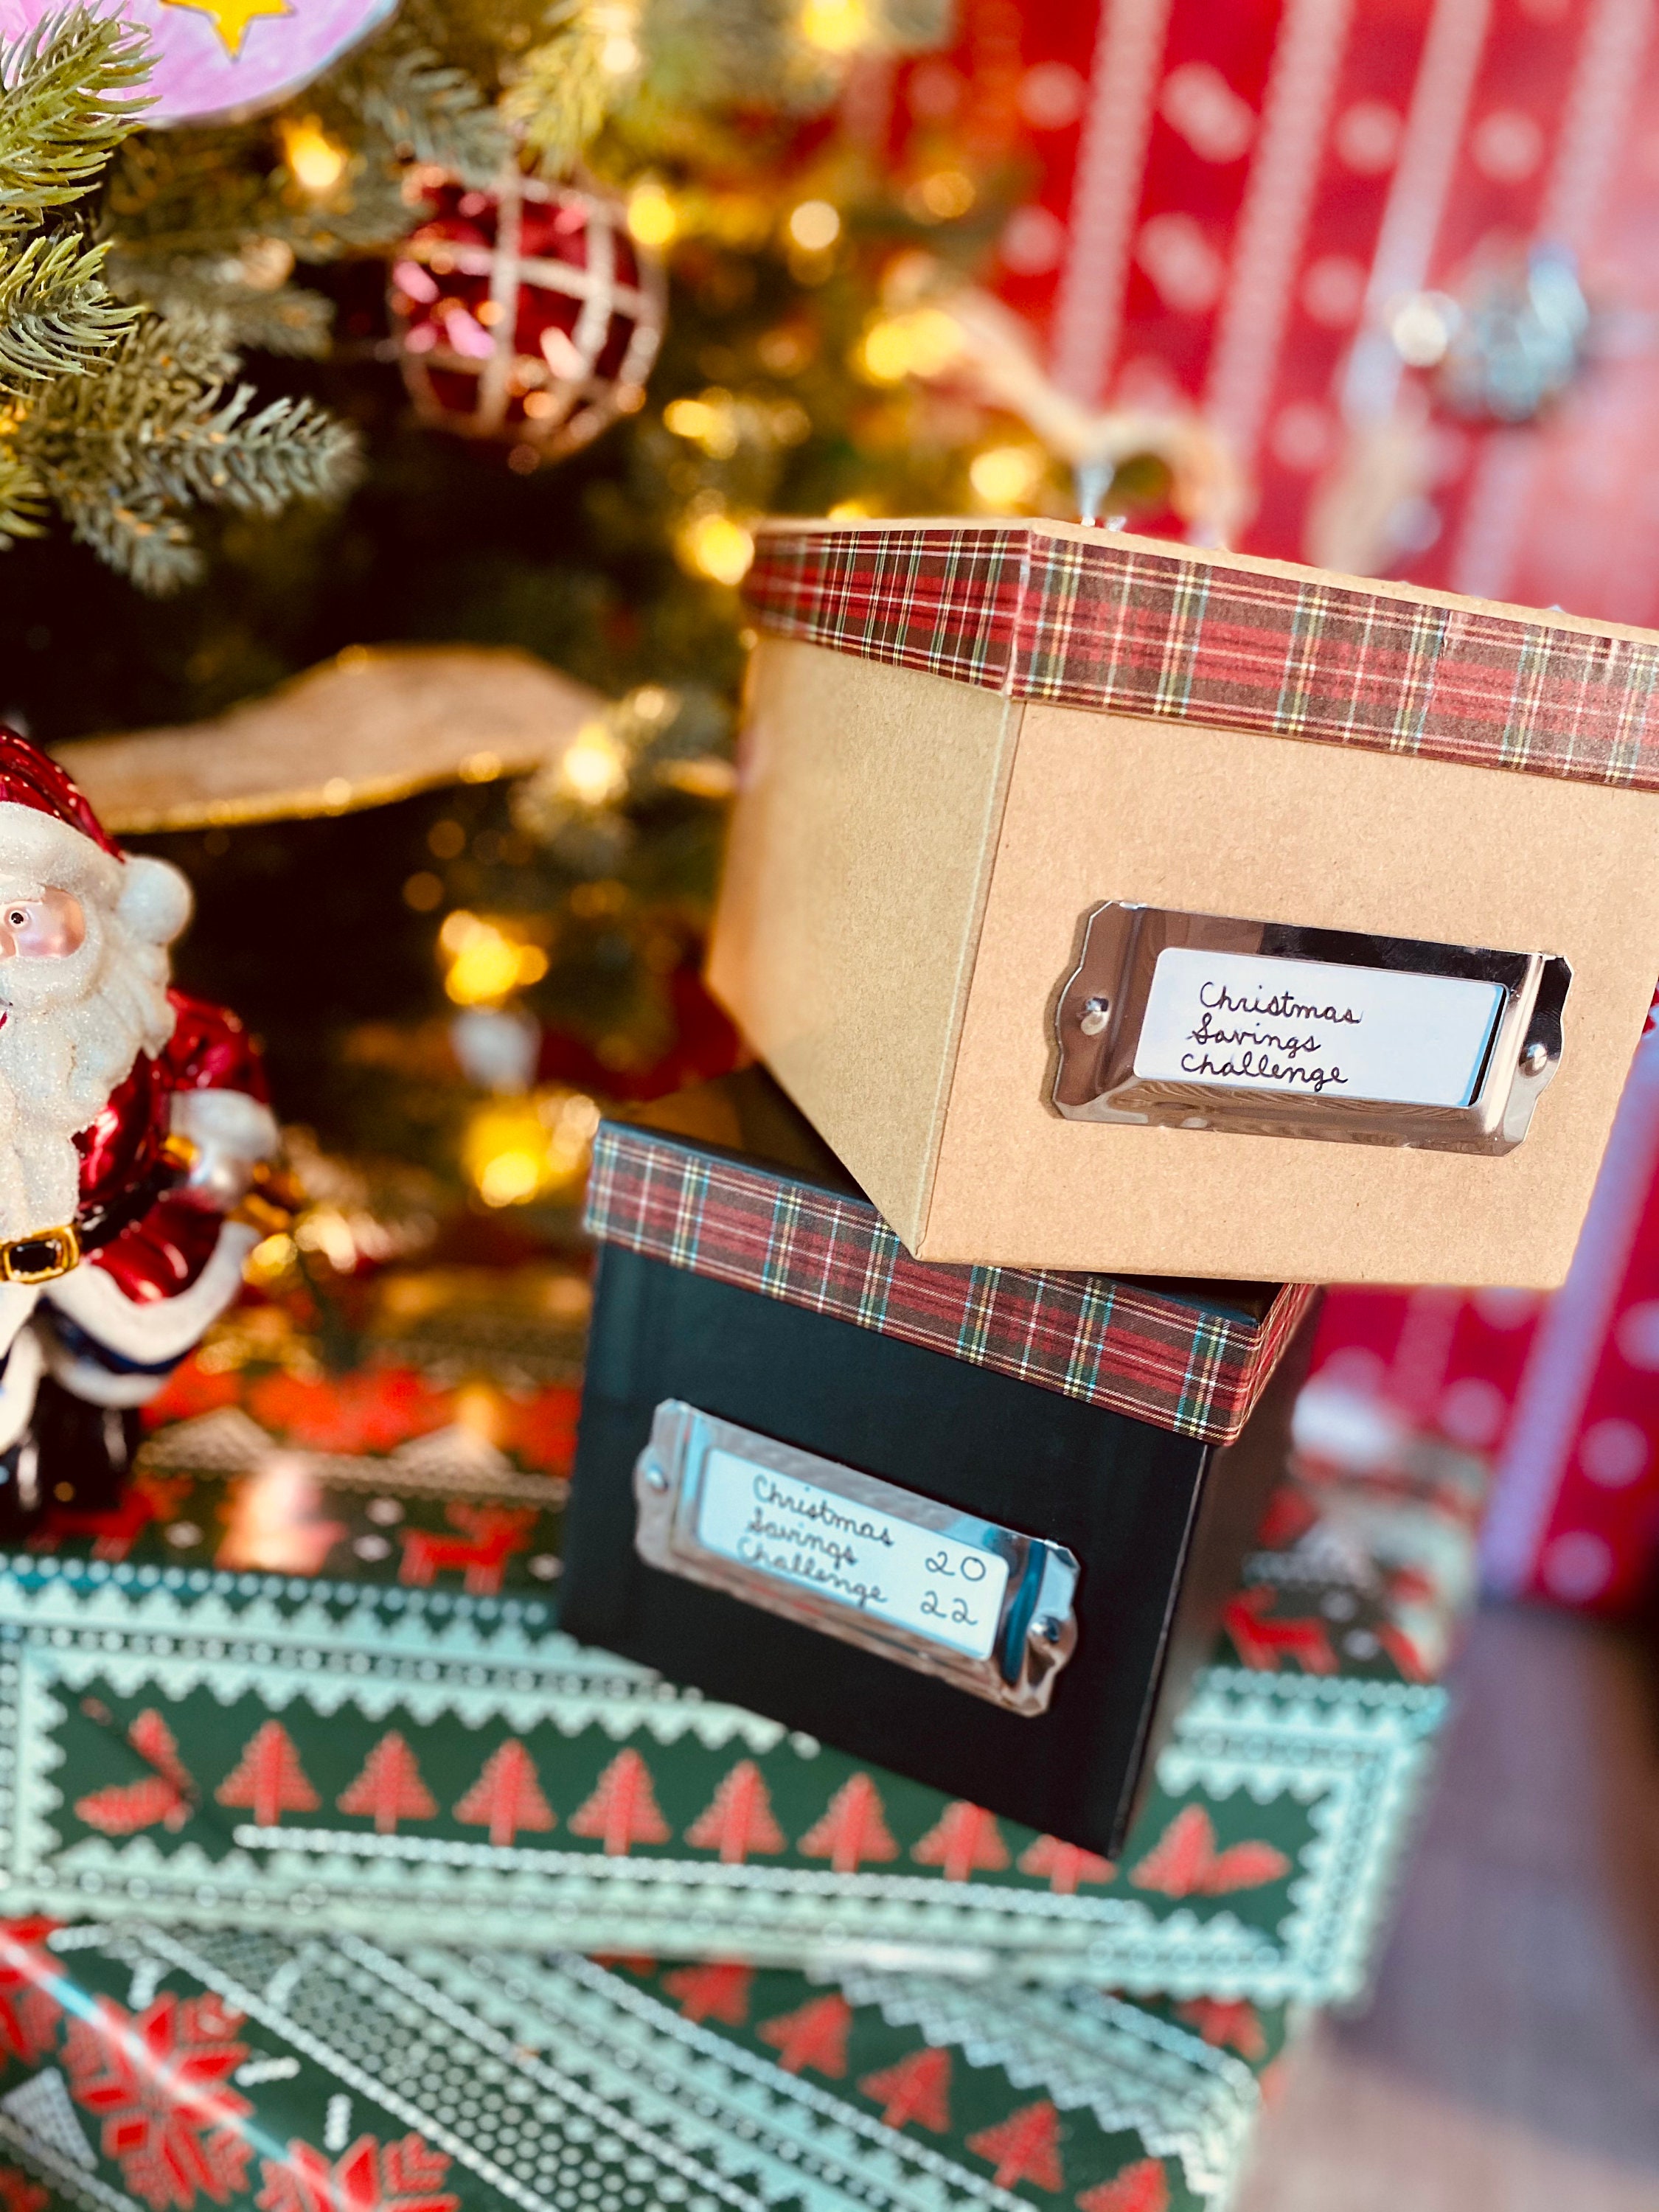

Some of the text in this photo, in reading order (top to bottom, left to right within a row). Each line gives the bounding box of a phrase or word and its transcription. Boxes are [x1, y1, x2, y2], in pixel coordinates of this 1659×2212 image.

[1200, 981, 1362, 1024] Christmas
[1186, 1014, 1321, 1059] Savings
[754, 1475, 894, 1547] Christmas
[746, 1508, 858, 1570] Savings
[737, 1536, 888, 1608] Challenge
[925, 1551, 987, 1582] 20
[920, 1590, 978, 1626] 22
